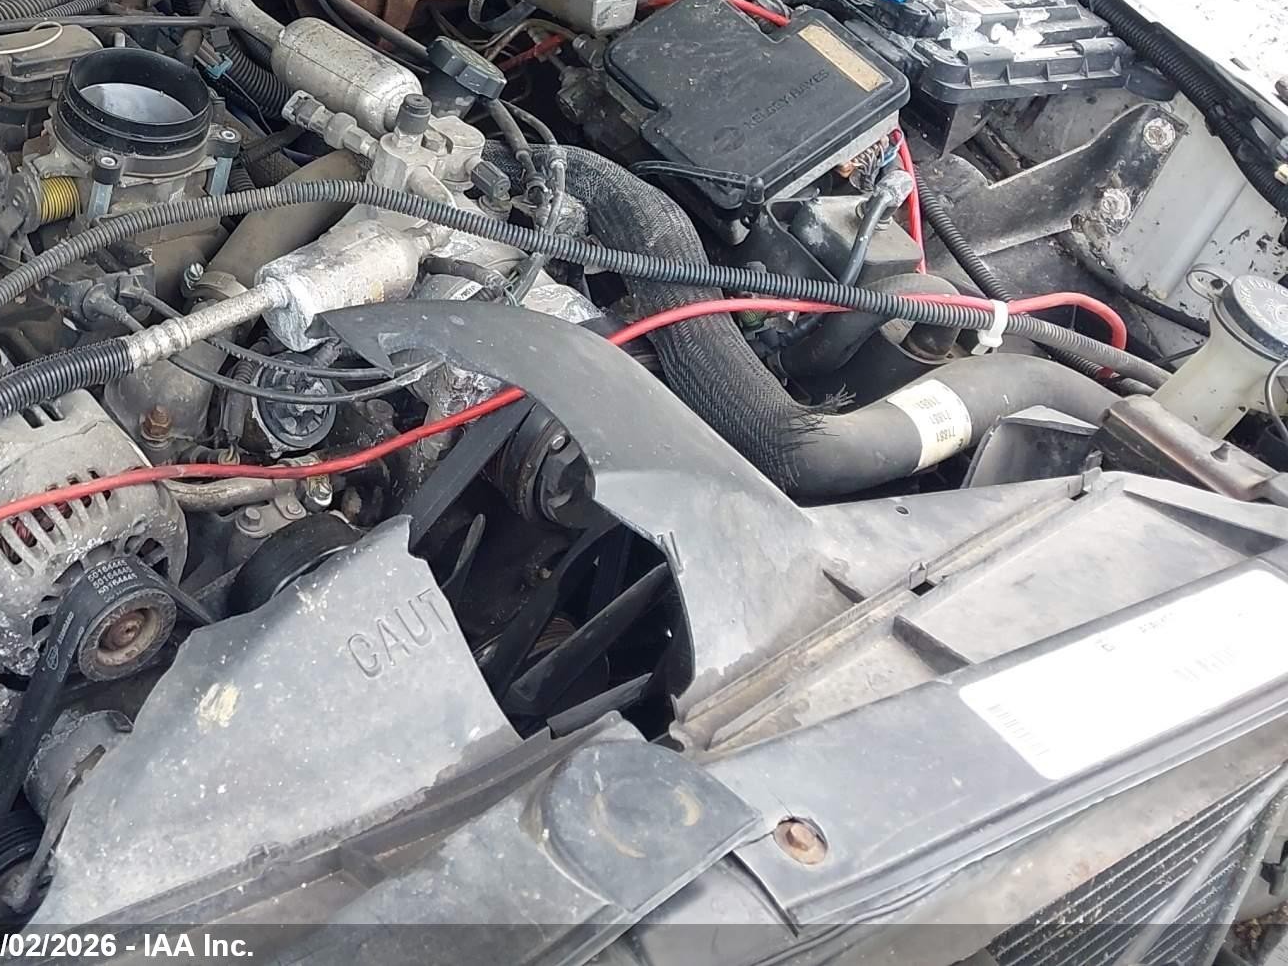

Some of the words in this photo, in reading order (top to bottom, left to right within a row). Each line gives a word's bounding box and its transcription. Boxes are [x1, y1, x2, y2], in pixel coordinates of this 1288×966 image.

[87, 559, 128, 582] 50164445
[92, 566, 133, 589] 50164445
[97, 573, 138, 595] 50164445
[348, 588, 450, 679] CAUT
